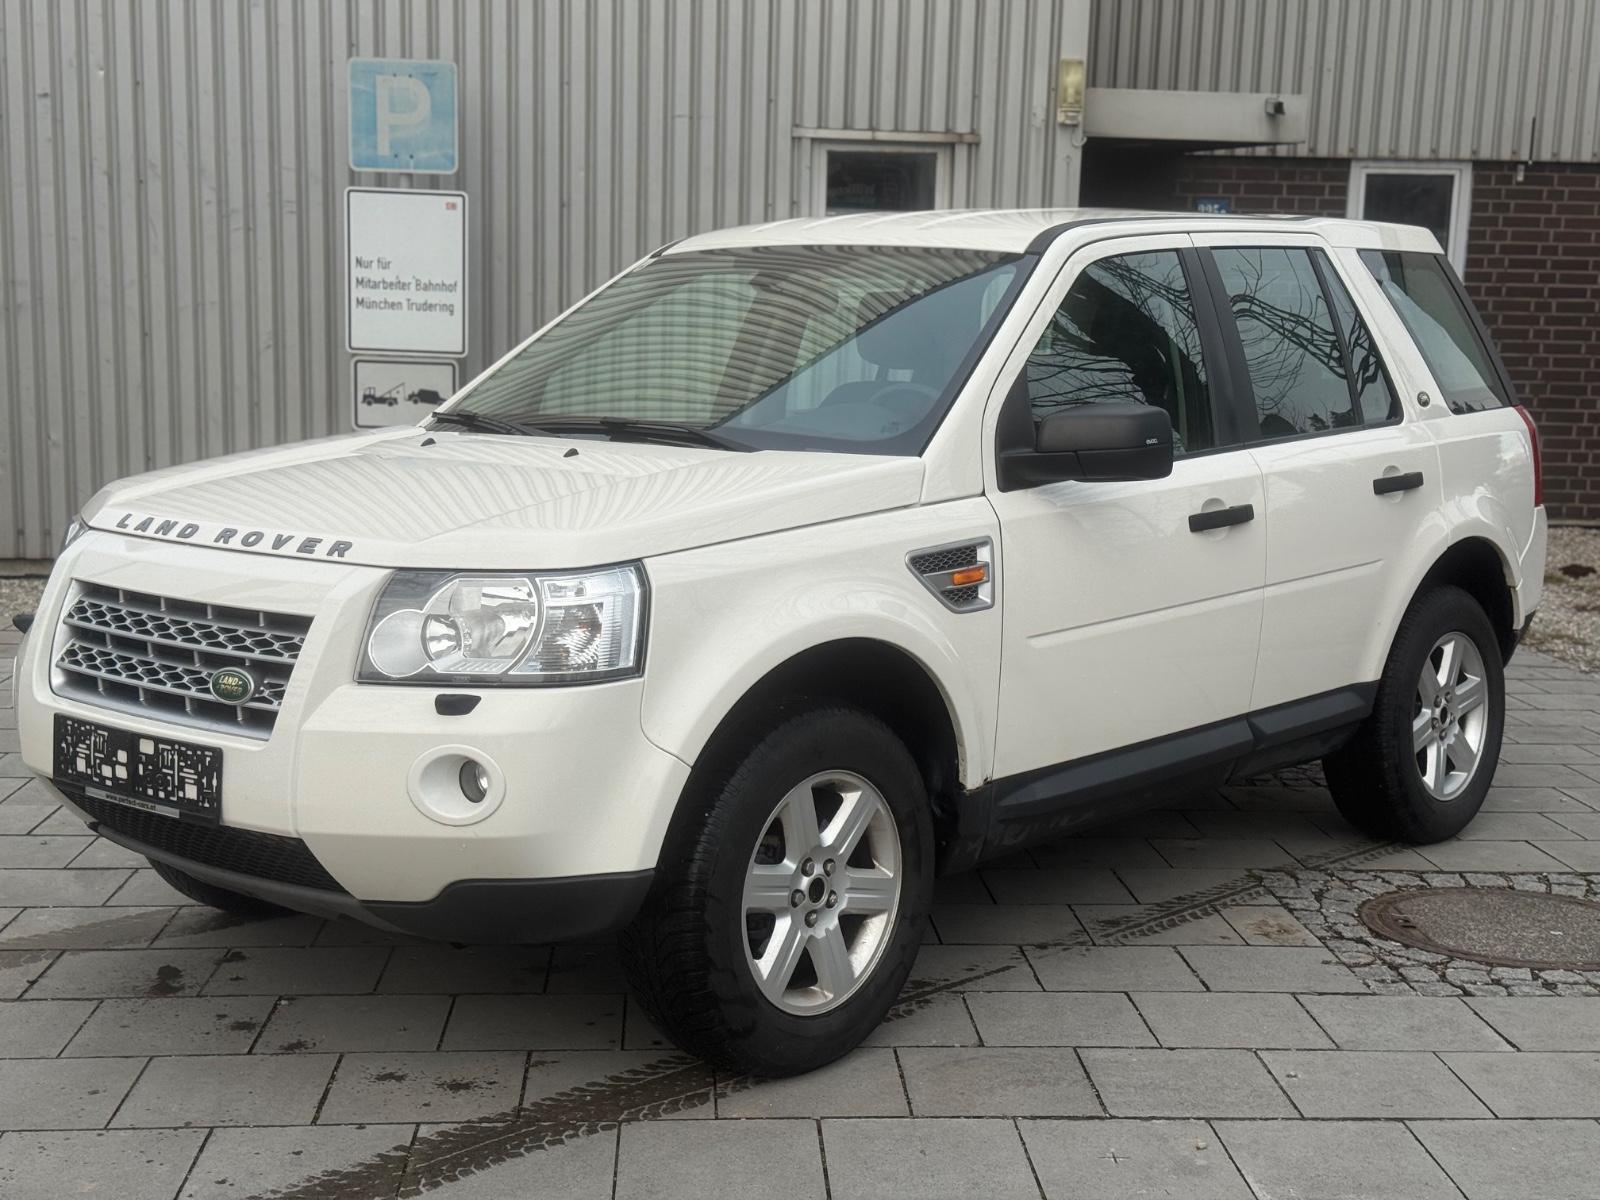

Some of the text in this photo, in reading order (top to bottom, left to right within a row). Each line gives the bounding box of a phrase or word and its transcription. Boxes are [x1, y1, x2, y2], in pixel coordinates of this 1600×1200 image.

[375, 74, 432, 156] P
[355, 256, 392, 270] Nur für
[355, 277, 458, 293] Mitarbeiter Bahnhof
[355, 297, 455, 316] München Trudering
[116, 513, 353, 558] LAND ROVER
